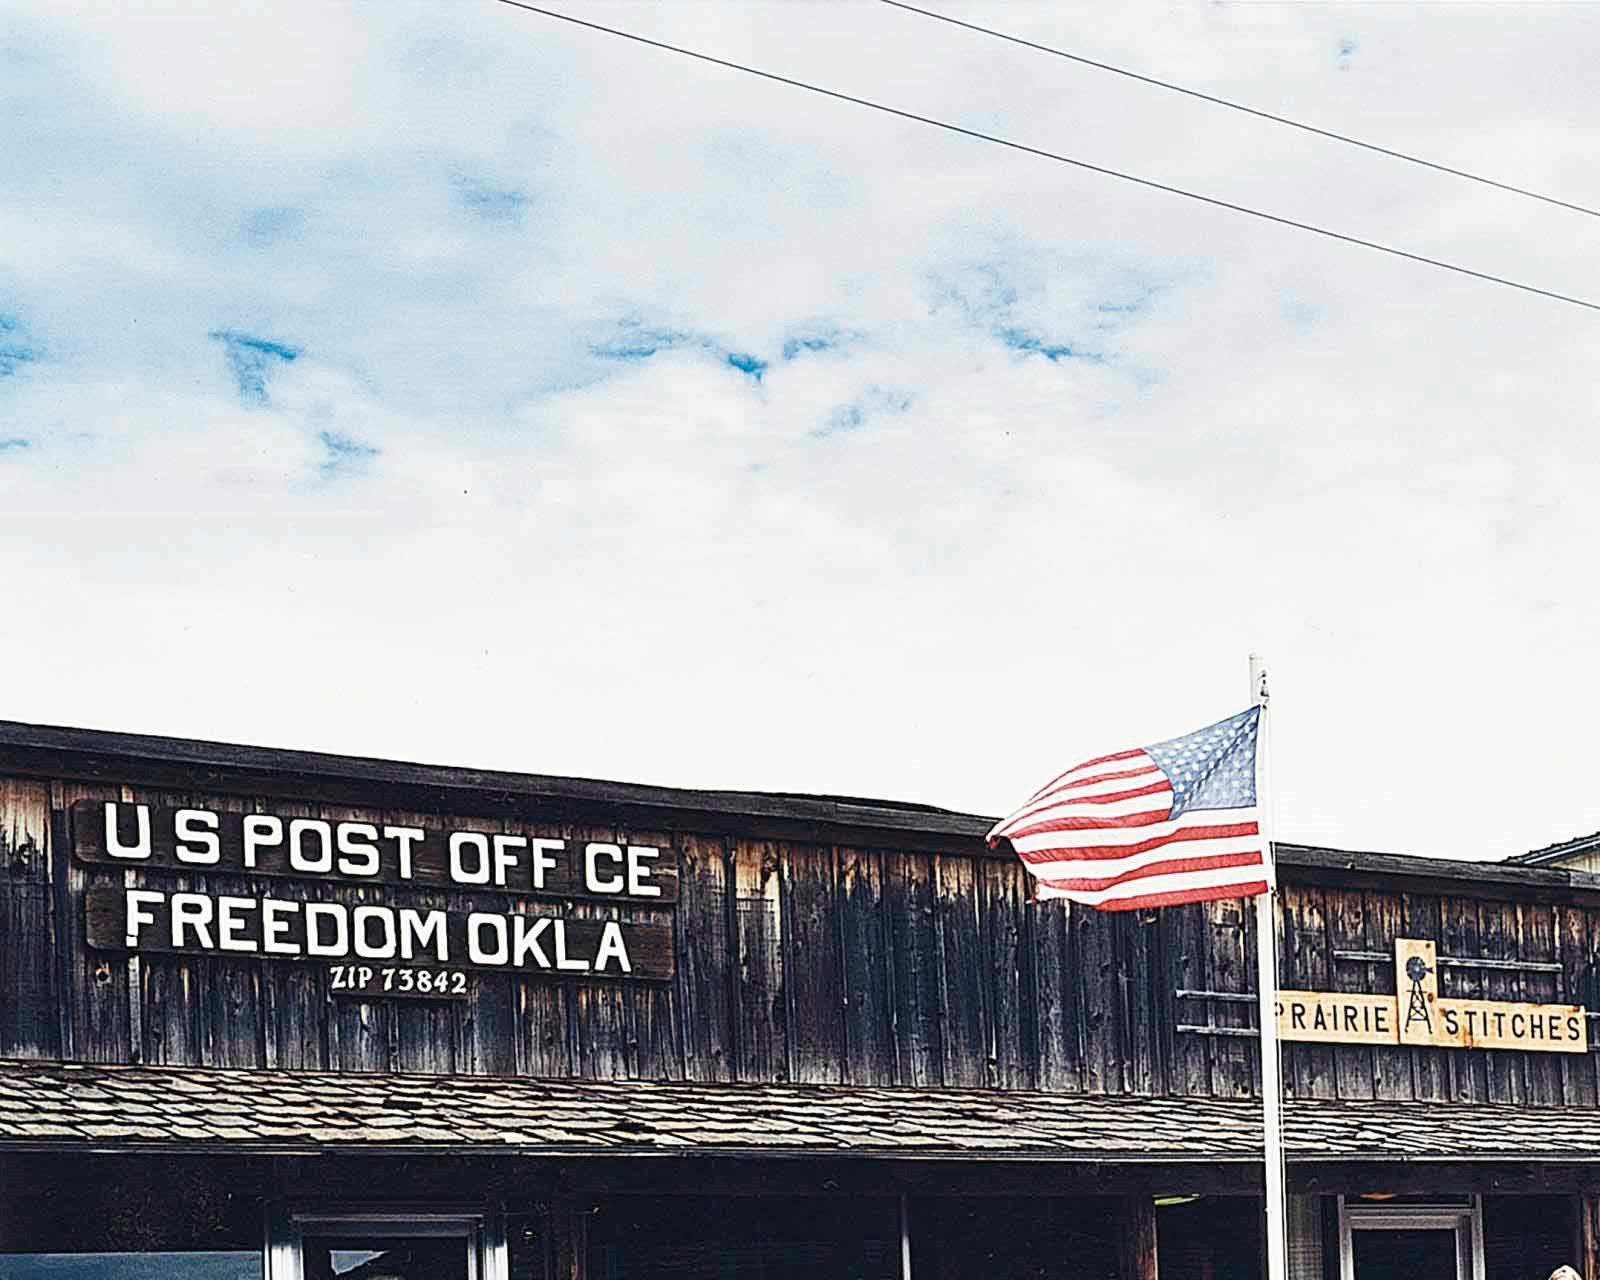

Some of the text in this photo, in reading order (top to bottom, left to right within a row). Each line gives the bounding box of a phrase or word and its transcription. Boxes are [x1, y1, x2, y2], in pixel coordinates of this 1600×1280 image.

[105, 802, 152, 858] U
[175, 808, 221, 864] S
[244, 814, 425, 880] POST
[125, 889, 632, 973] FREEDOM OKLA
[329, 965, 467, 994] ZIP 73842
[1445, 1009, 1580, 1041] STITCHES
